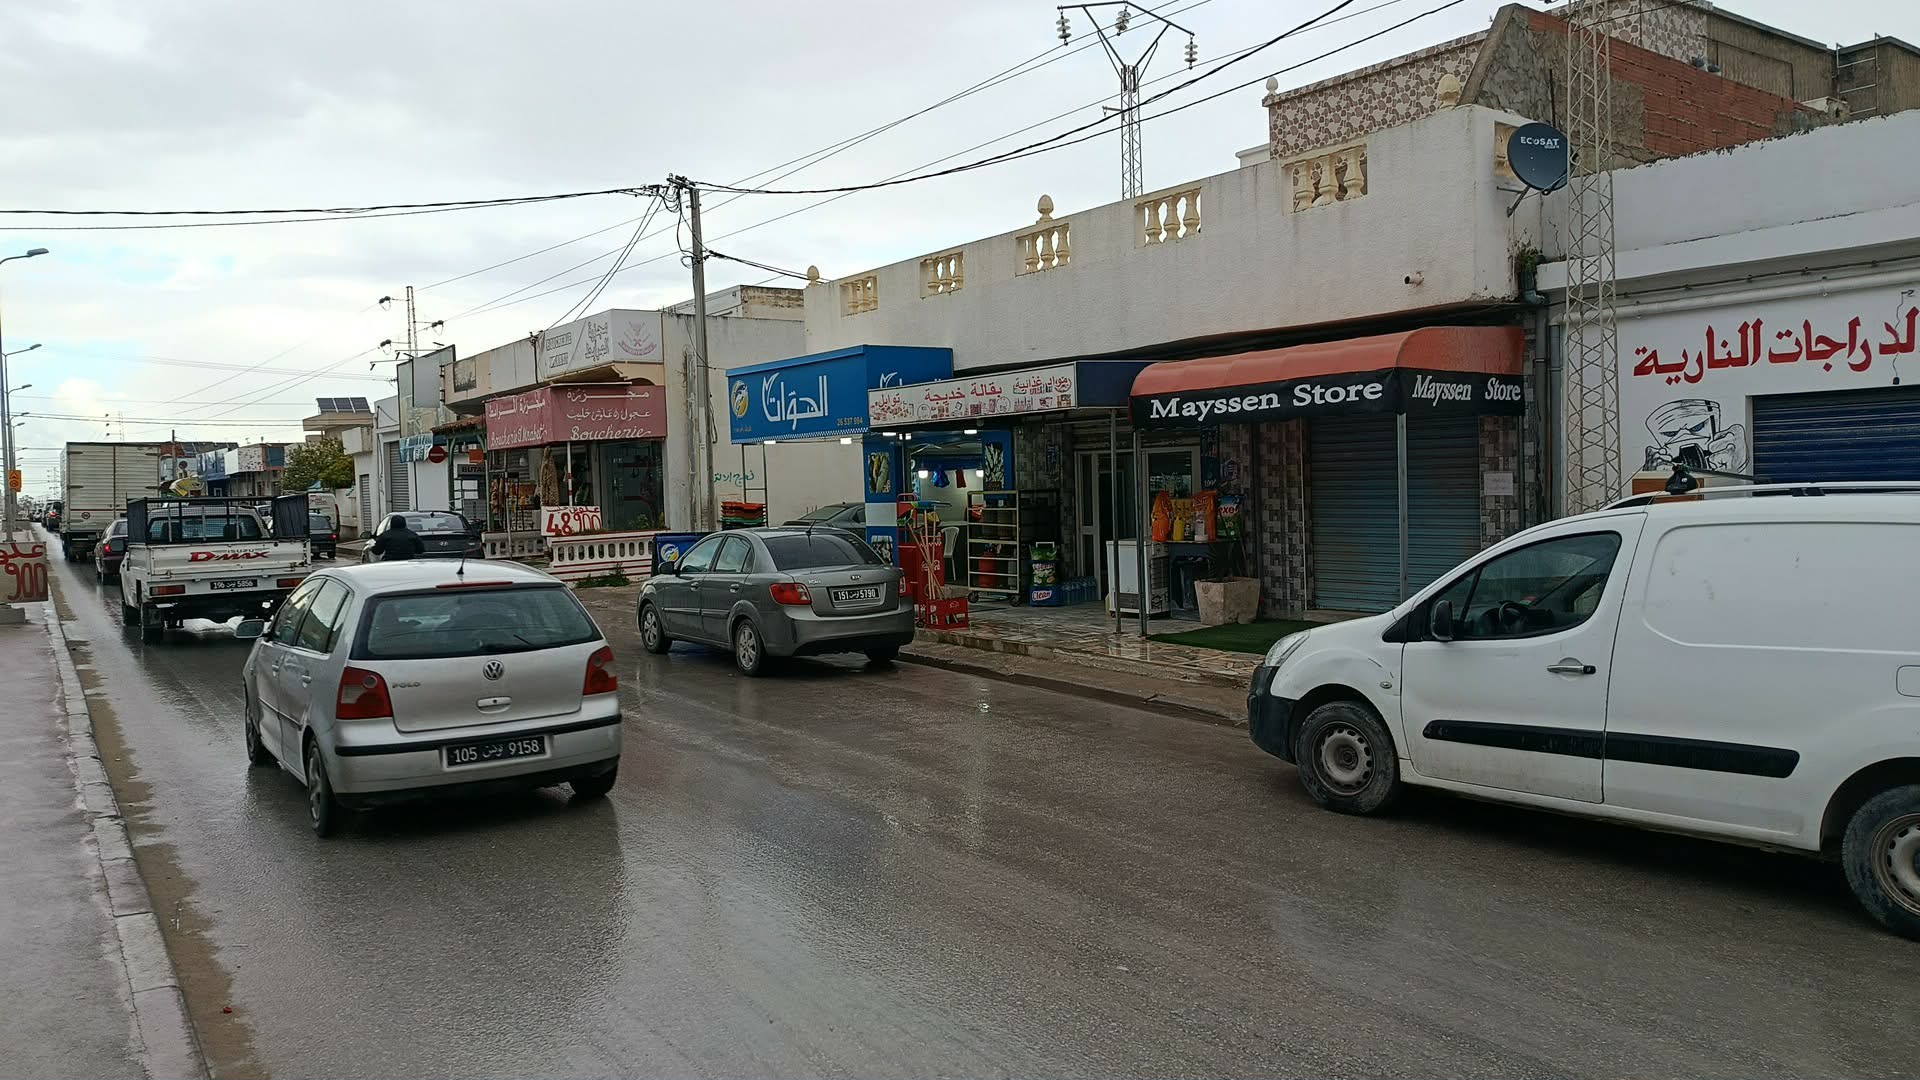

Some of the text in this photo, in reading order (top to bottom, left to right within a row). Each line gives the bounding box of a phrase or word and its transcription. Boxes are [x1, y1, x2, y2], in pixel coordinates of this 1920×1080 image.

[1520, 136, 1560, 146] ECOSAT
[1633, 318, 1763, 385] النارية
[925, 382, 1003, 405] بقالة خديجة
[1150, 382, 1383, 422] Mayssen Store
[1412, 374, 1521, 407] Mayssen Store
[570, 424, 652, 441] Boucherie
[547, 512, 573, 535] 48
[838, 591, 849, 600] 151
[860, 588, 876, 599] 5790
[455, 739, 540, 763] 105 تونس 9158
